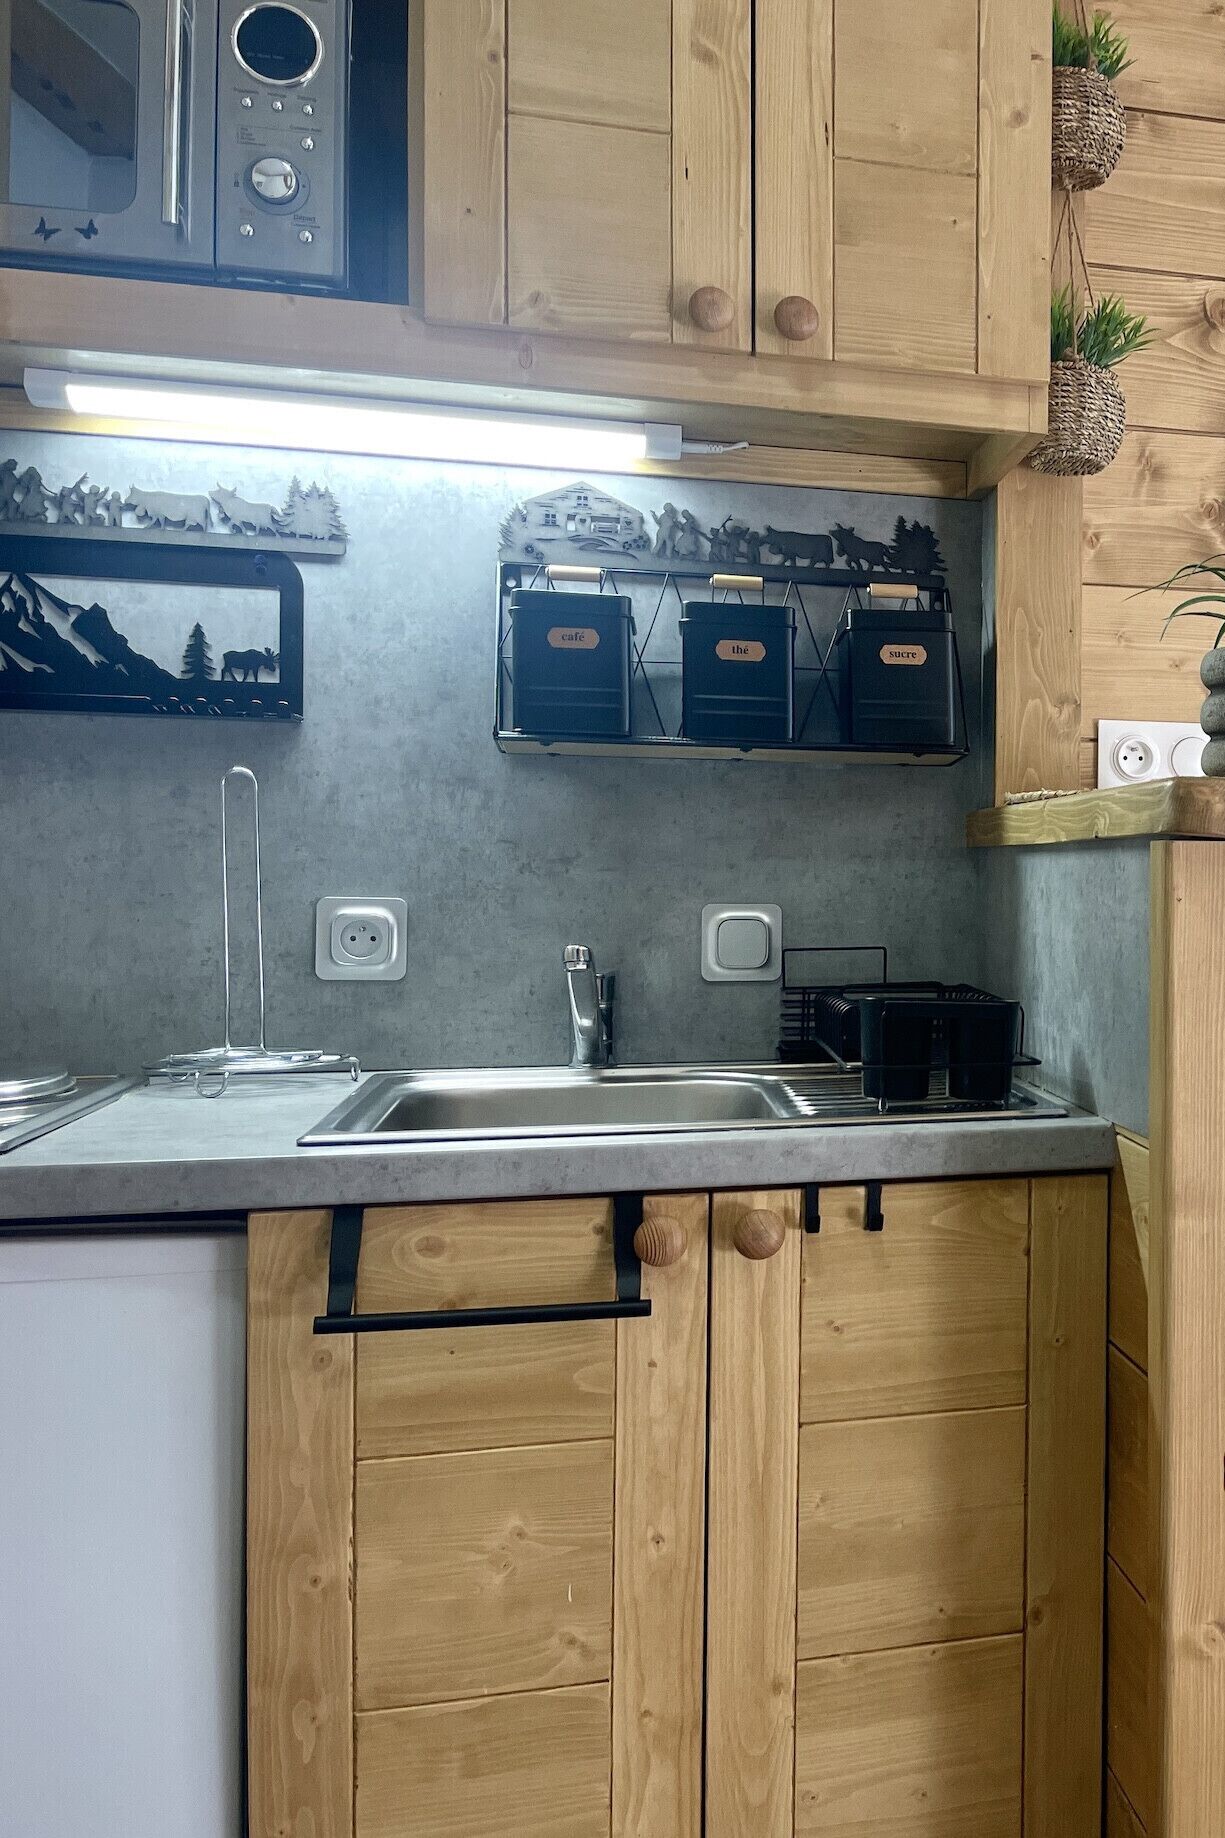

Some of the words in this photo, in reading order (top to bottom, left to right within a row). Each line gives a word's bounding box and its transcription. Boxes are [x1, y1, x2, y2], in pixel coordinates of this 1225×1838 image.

[561, 631, 585, 641] café
[732, 644, 749, 655] thé
[889, 650, 917, 659] sucre
